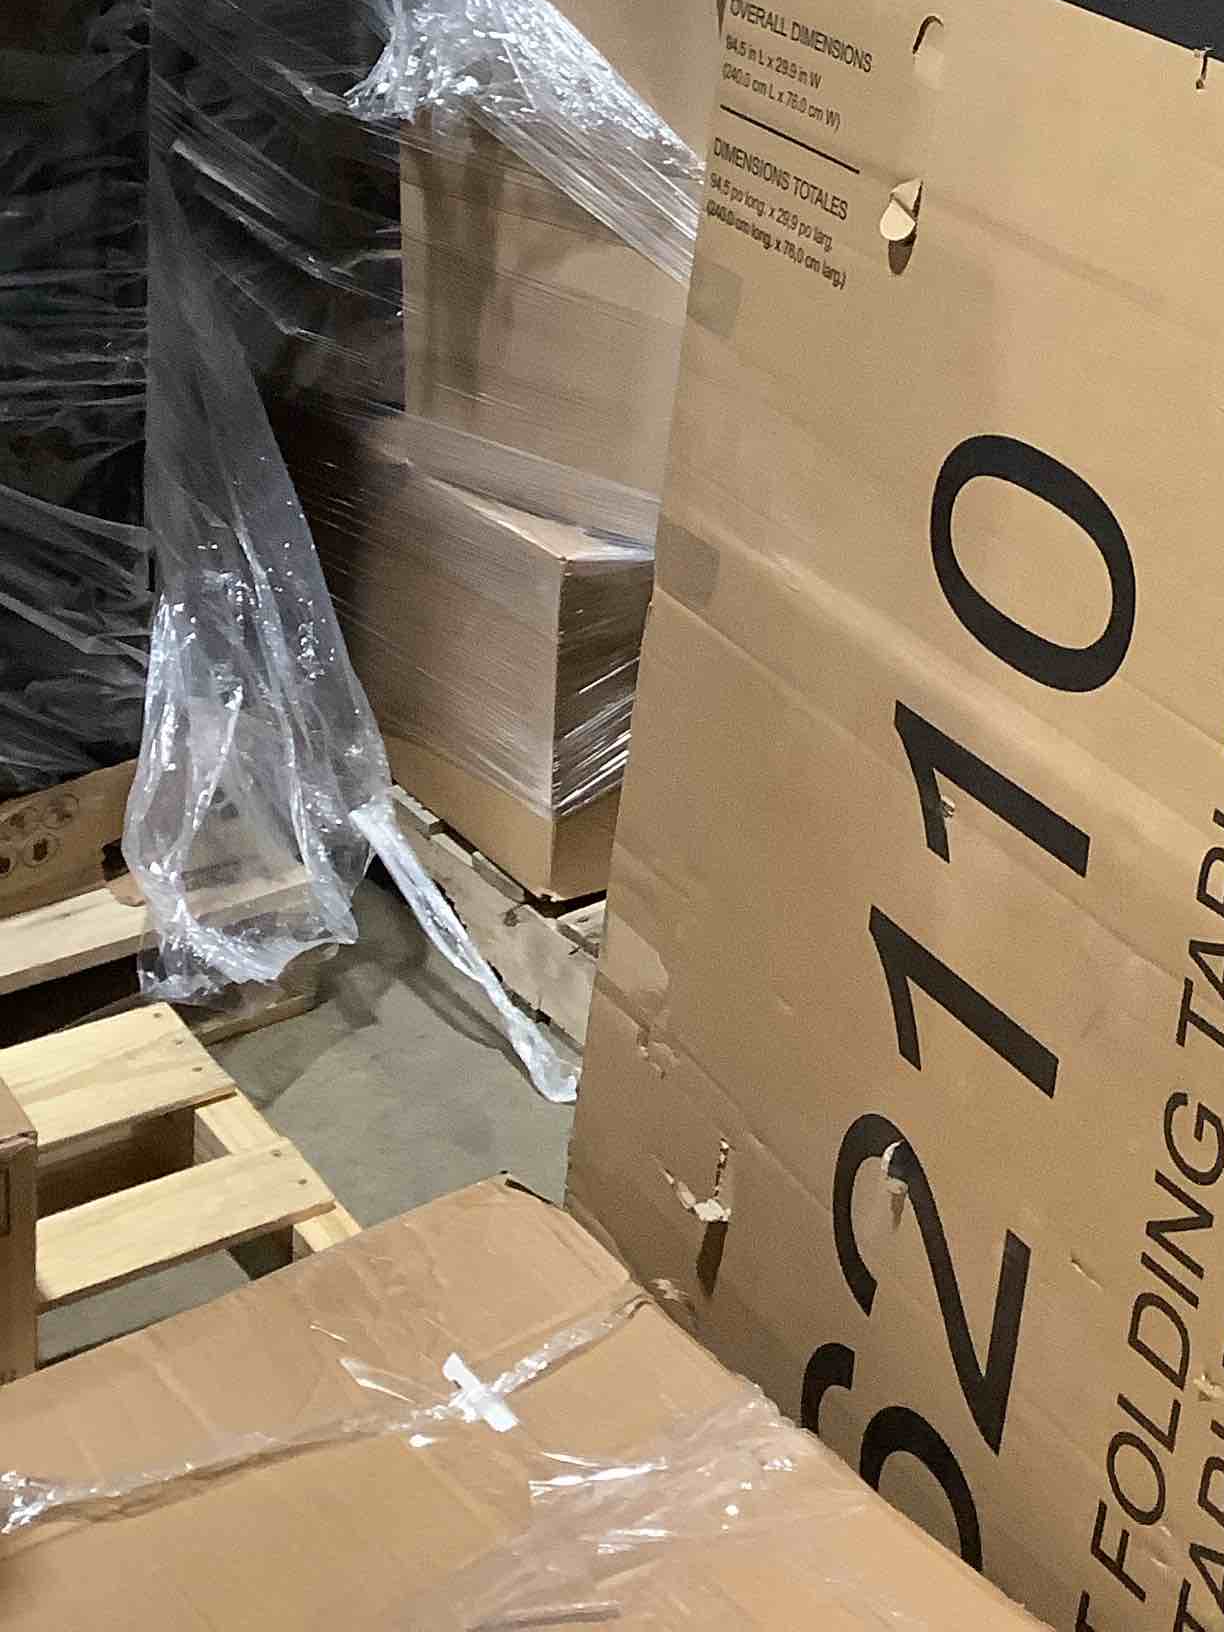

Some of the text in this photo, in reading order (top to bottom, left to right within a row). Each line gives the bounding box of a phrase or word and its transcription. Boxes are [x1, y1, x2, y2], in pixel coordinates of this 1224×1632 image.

[758, 49, 765, 66] L
[766, 56, 773, 68] x
[809, 72, 823, 89] W
[790, 21, 873, 73] DIMENSIONS
[752, 79, 767, 96] cm
[769, 82, 776, 100] L
[776, 90, 784, 104] x
[825, 109, 841, 131] W)
[713, 136, 849, 221] DIMENSIONS TOTALES
[730, 186, 743, 204] po
[768, 206, 775, 218] x
[799, 223, 813, 240] po
[774, 237, 782, 250] x
[805, 254, 821, 273] cm
